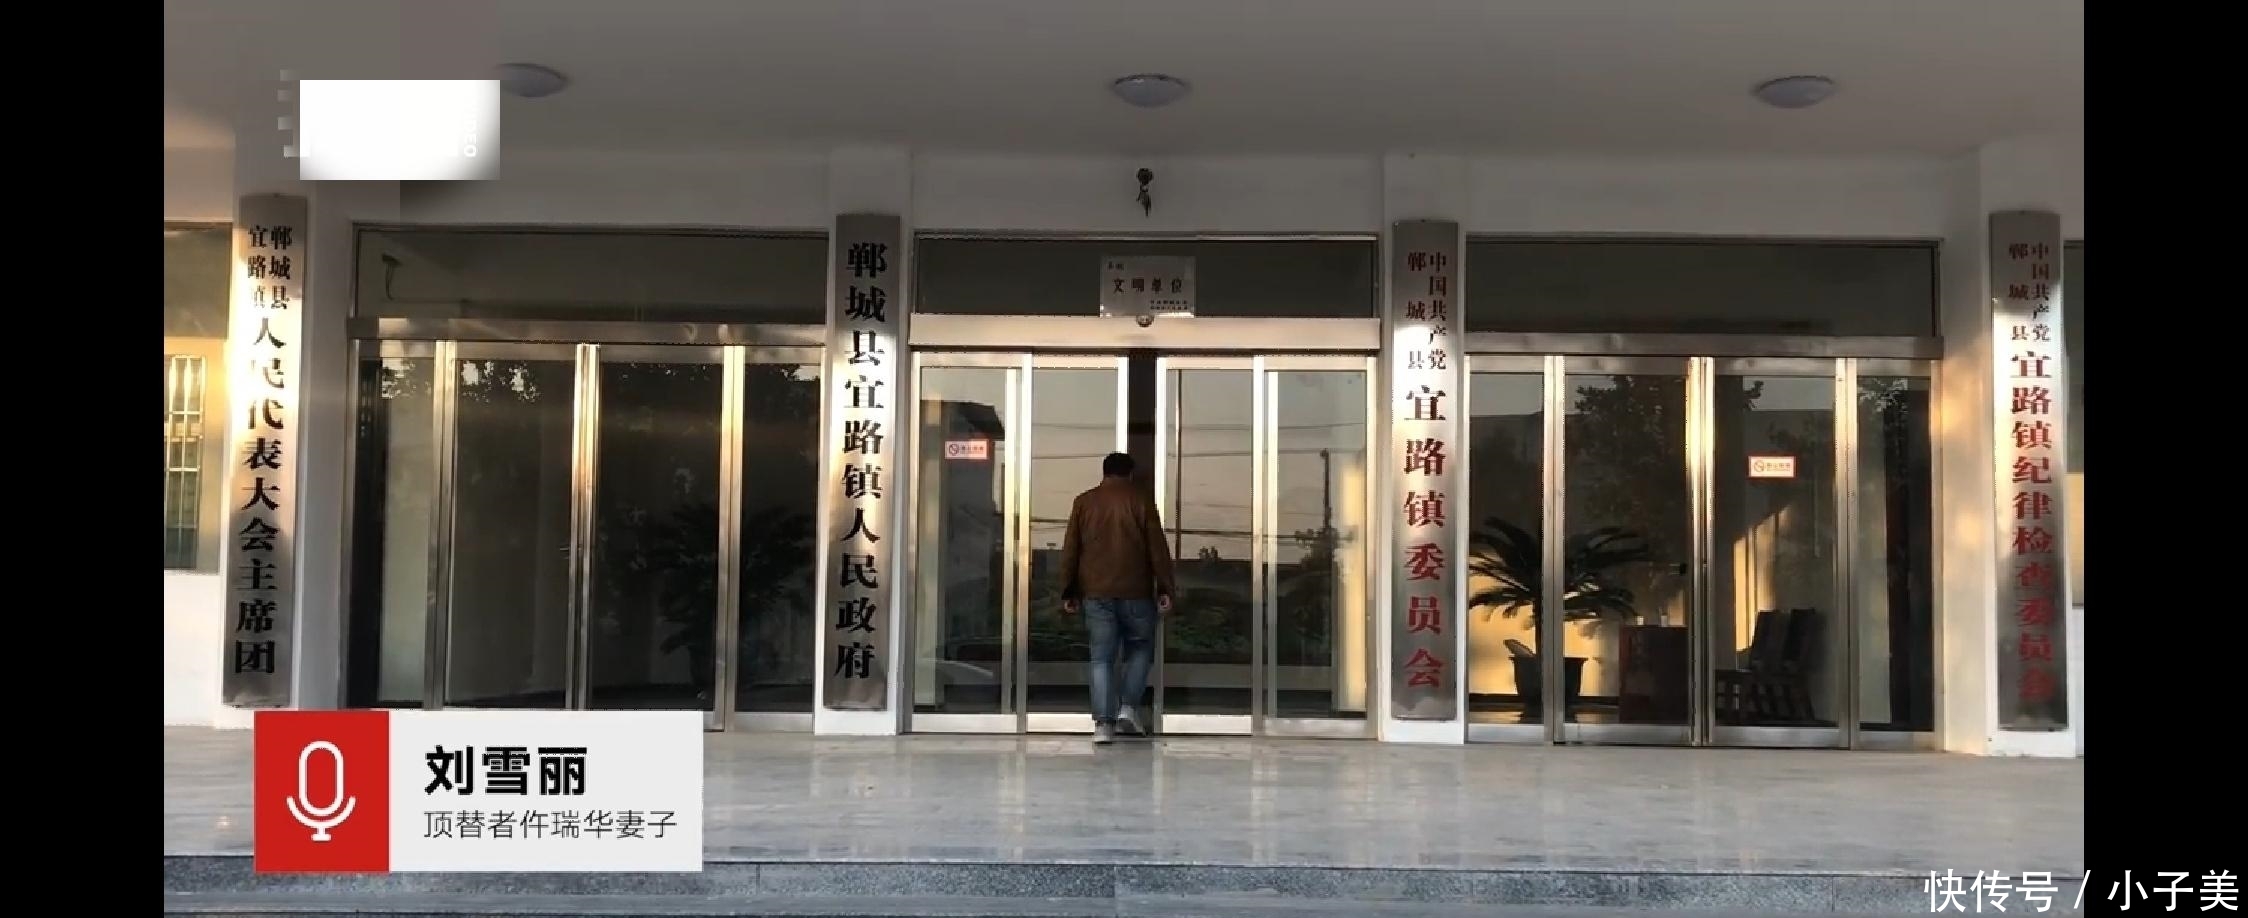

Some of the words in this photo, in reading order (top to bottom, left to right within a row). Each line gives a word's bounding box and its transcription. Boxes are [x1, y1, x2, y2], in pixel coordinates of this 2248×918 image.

[269, 225, 293, 309] 郸城县
[1406, 252, 1426, 370] 郸城县
[1428, 252, 1447, 370] 中国共产党
[2008, 242, 2029, 341] 郸城县
[2031, 242, 2051, 342] 中国共产党
[834, 242, 888, 679] 郸城县宜路镇人民政府
[1404, 385, 1447, 689] 宜路镇委员会
[2010, 351, 2056, 701] 宜路镇纪律检查委员会
